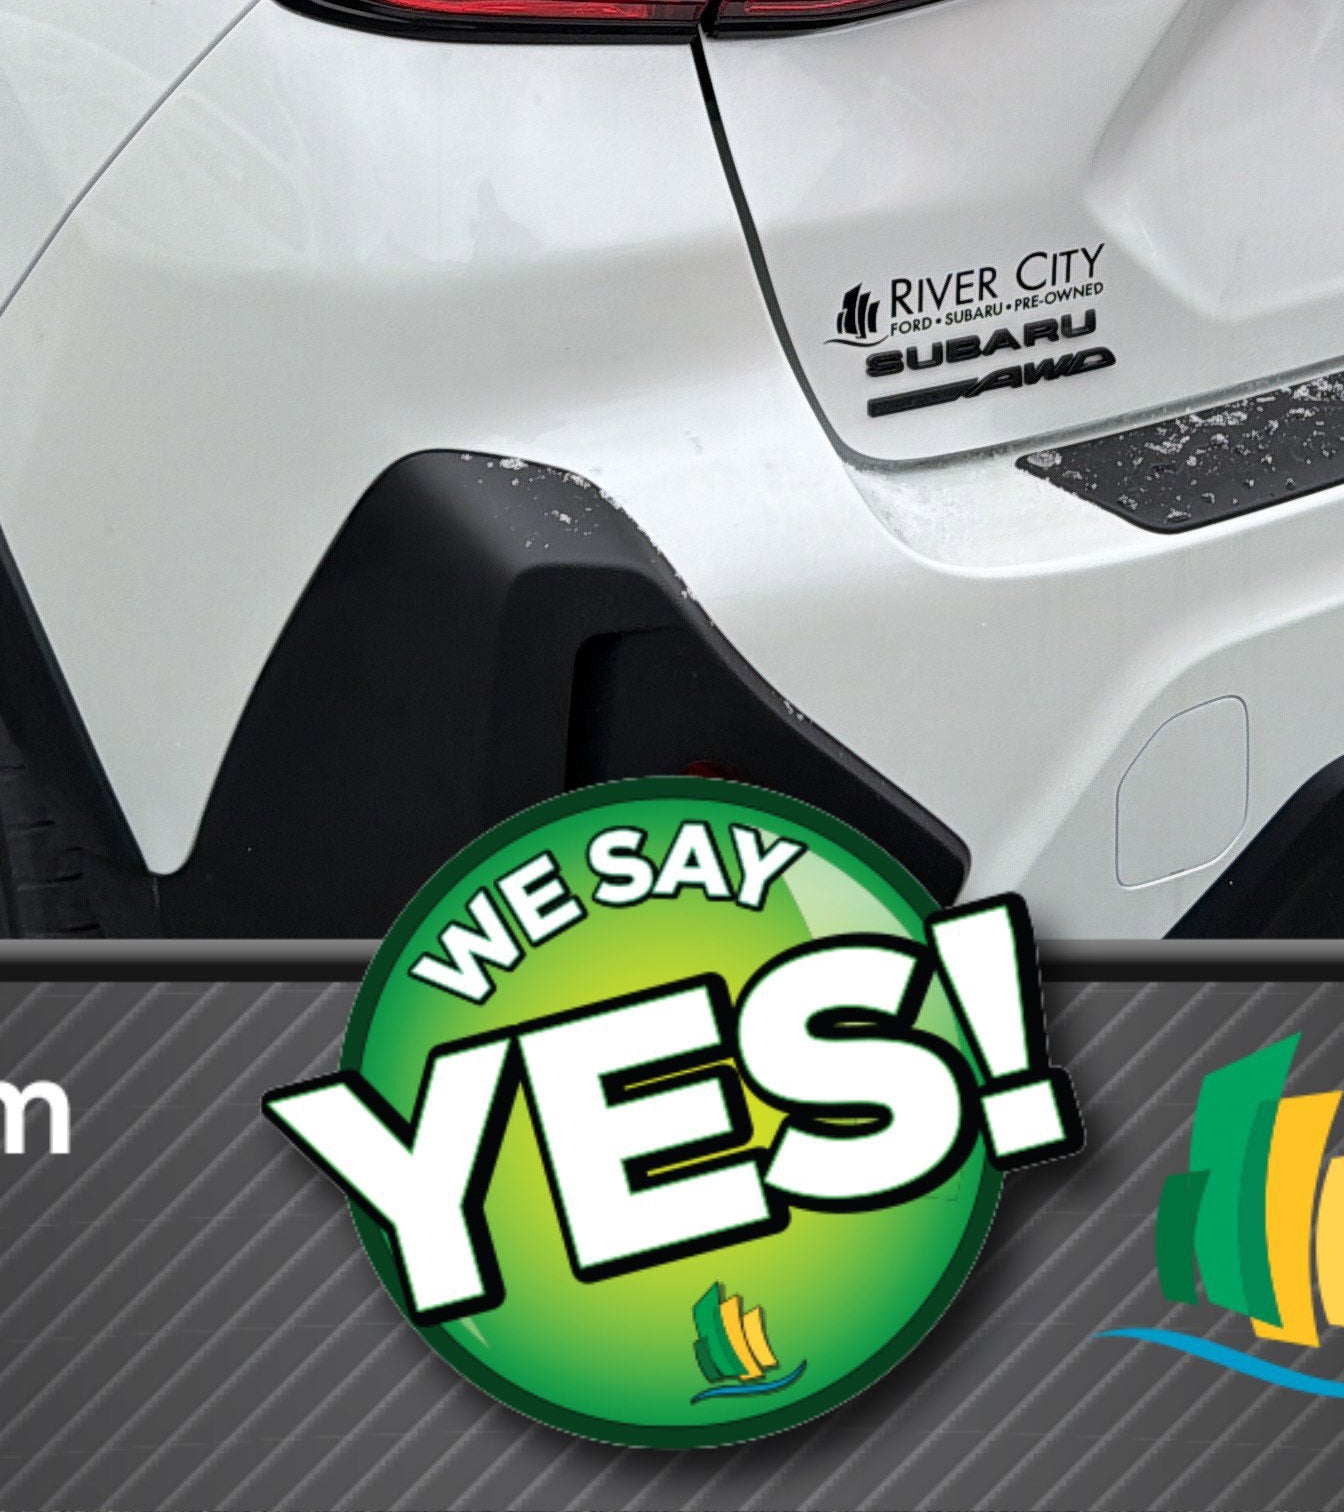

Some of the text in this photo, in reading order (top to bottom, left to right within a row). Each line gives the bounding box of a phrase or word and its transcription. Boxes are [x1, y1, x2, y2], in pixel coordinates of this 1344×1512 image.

[890, 281, 1105, 337] FORD SUBARU PRE-OWNED
[891, 242, 1105, 318] RIVER CITY
[865, 308, 1097, 378] SUBARU
[956, 346, 1117, 399] AWD
